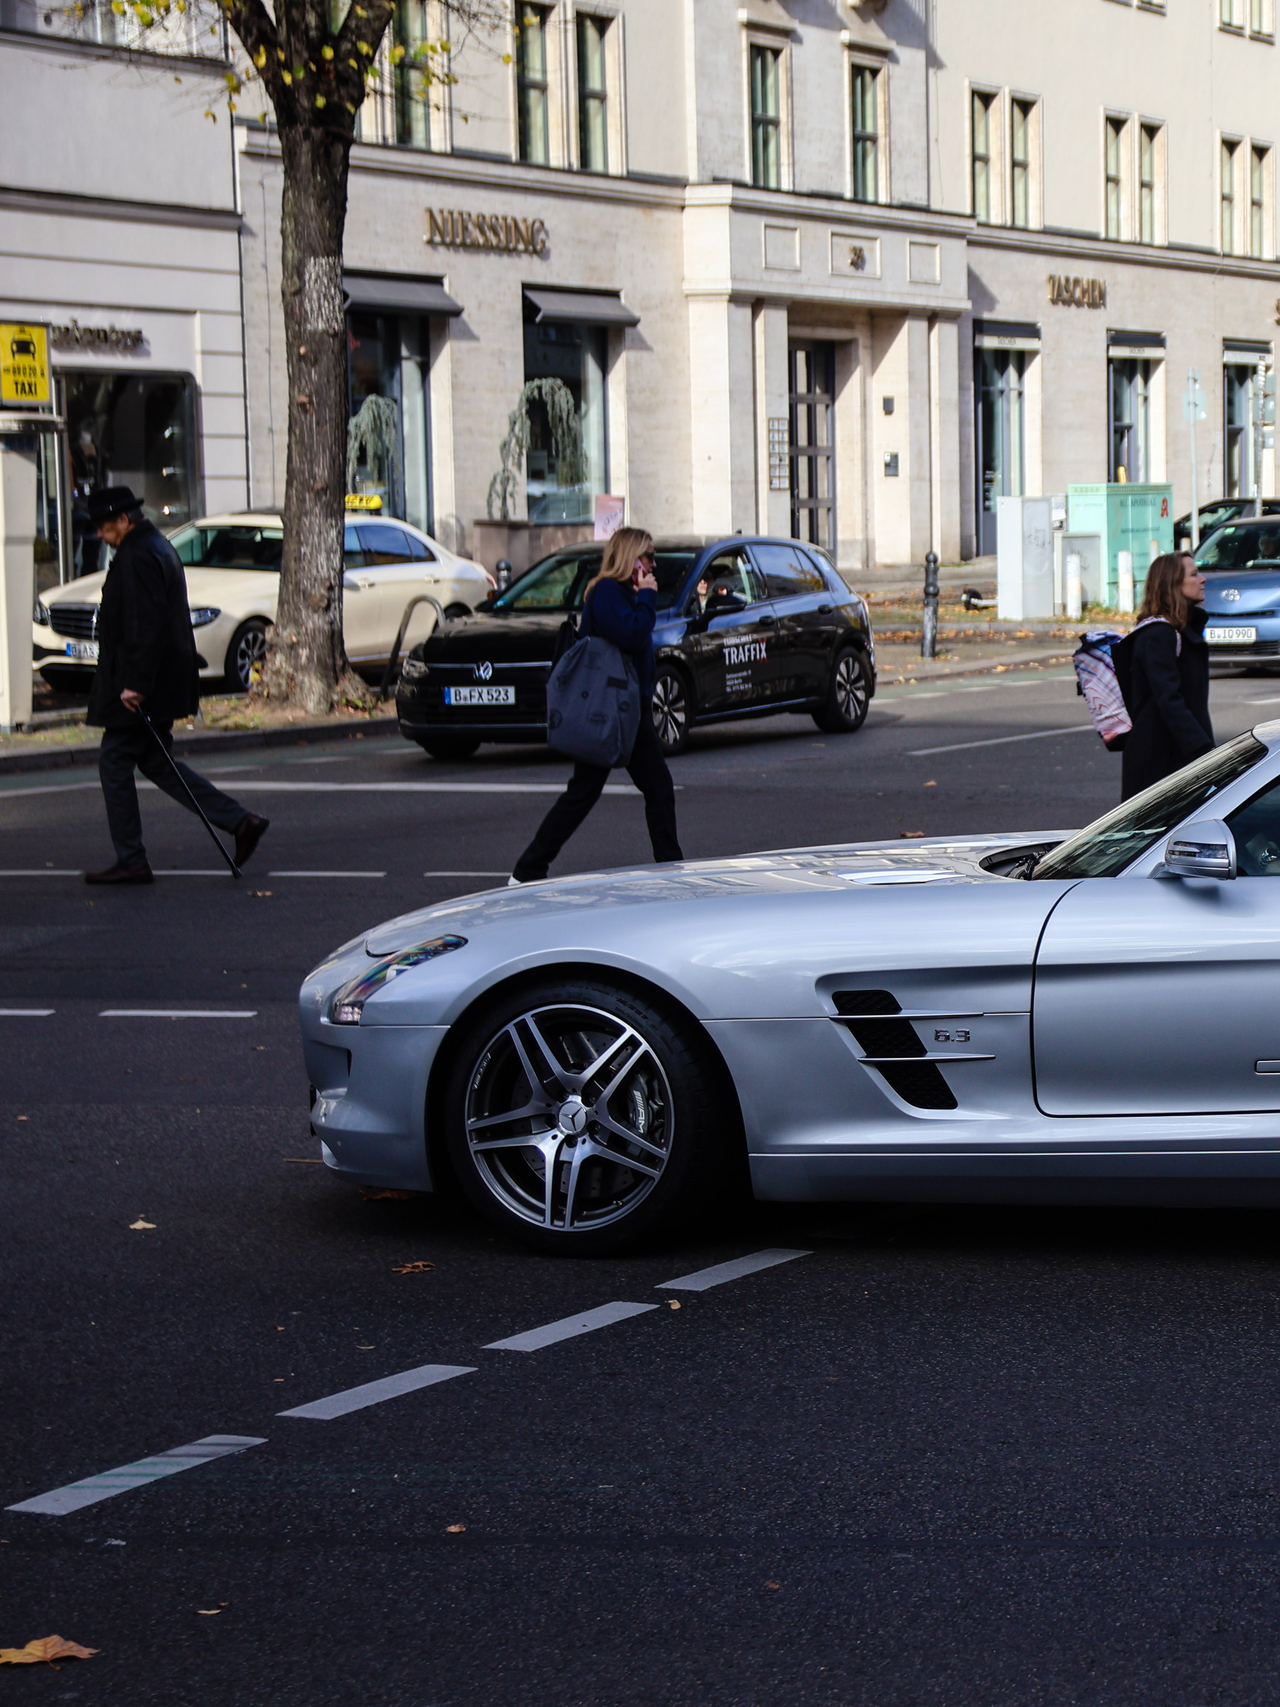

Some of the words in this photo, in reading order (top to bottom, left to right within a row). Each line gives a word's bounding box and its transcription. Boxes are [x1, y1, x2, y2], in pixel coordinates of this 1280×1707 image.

[424, 207, 546, 254] NIESSING
[1047, 274, 1106, 309] TASCHEN
[14, 380, 38, 397] TAXI
[723, 639, 768, 666] TRAFFIX
[454, 688, 462, 702] B
[469, 688, 484, 702] FX
[486, 688, 509, 702] 523
[934, 1029, 970, 1042] 6.3
